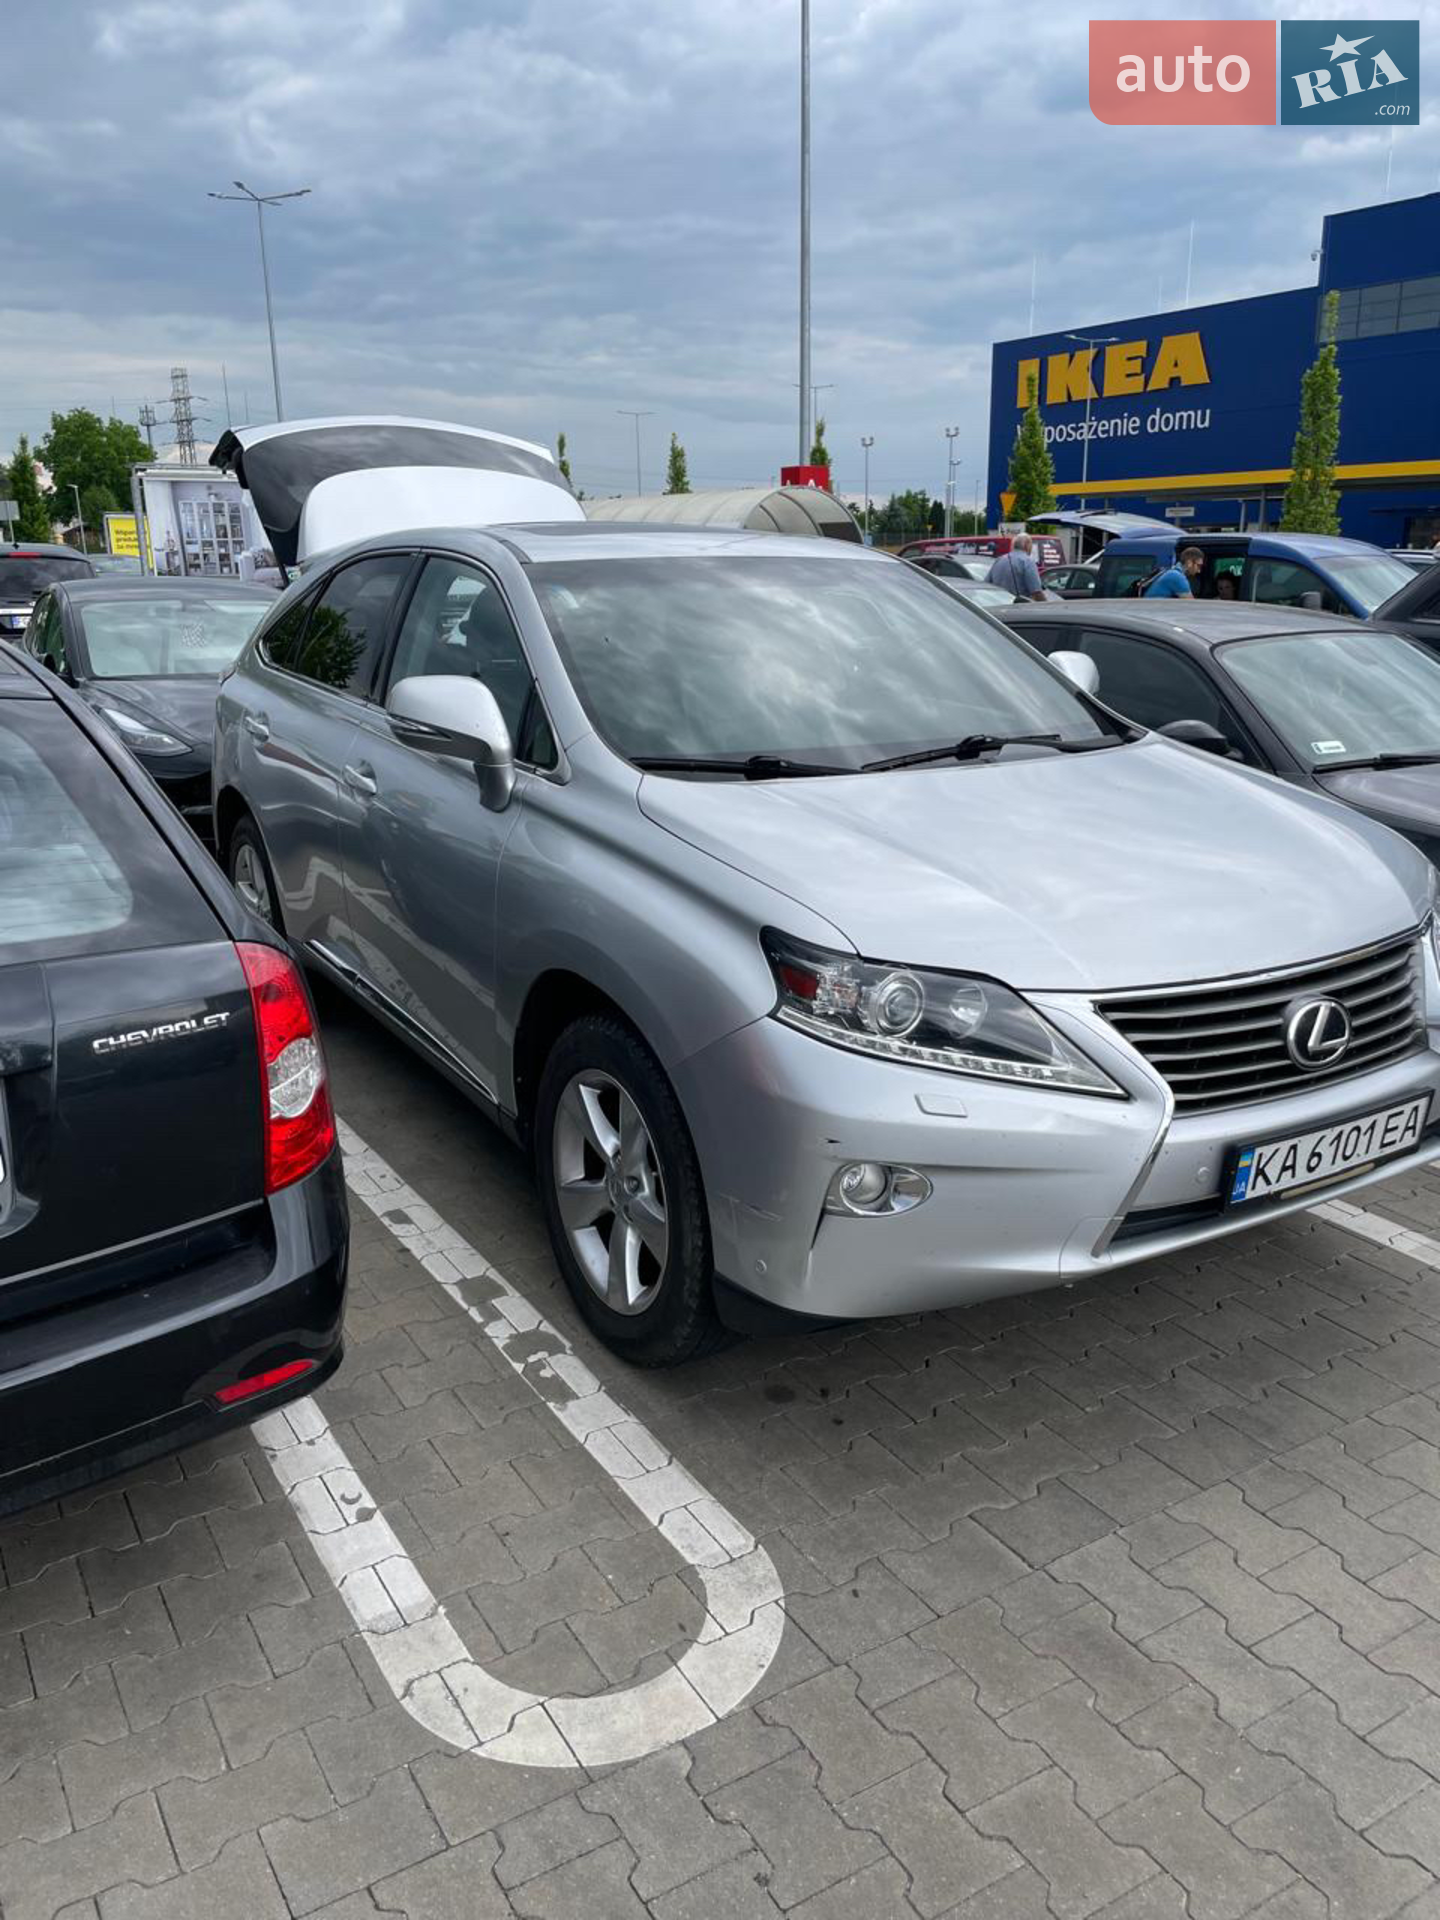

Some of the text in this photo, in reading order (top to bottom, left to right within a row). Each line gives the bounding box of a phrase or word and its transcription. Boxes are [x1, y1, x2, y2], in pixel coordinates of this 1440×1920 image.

[1017, 332, 1210, 408] IKEA
[1017, 407, 1211, 451] posażenie domu
[92, 1011, 231, 1054] CHEVROLET
